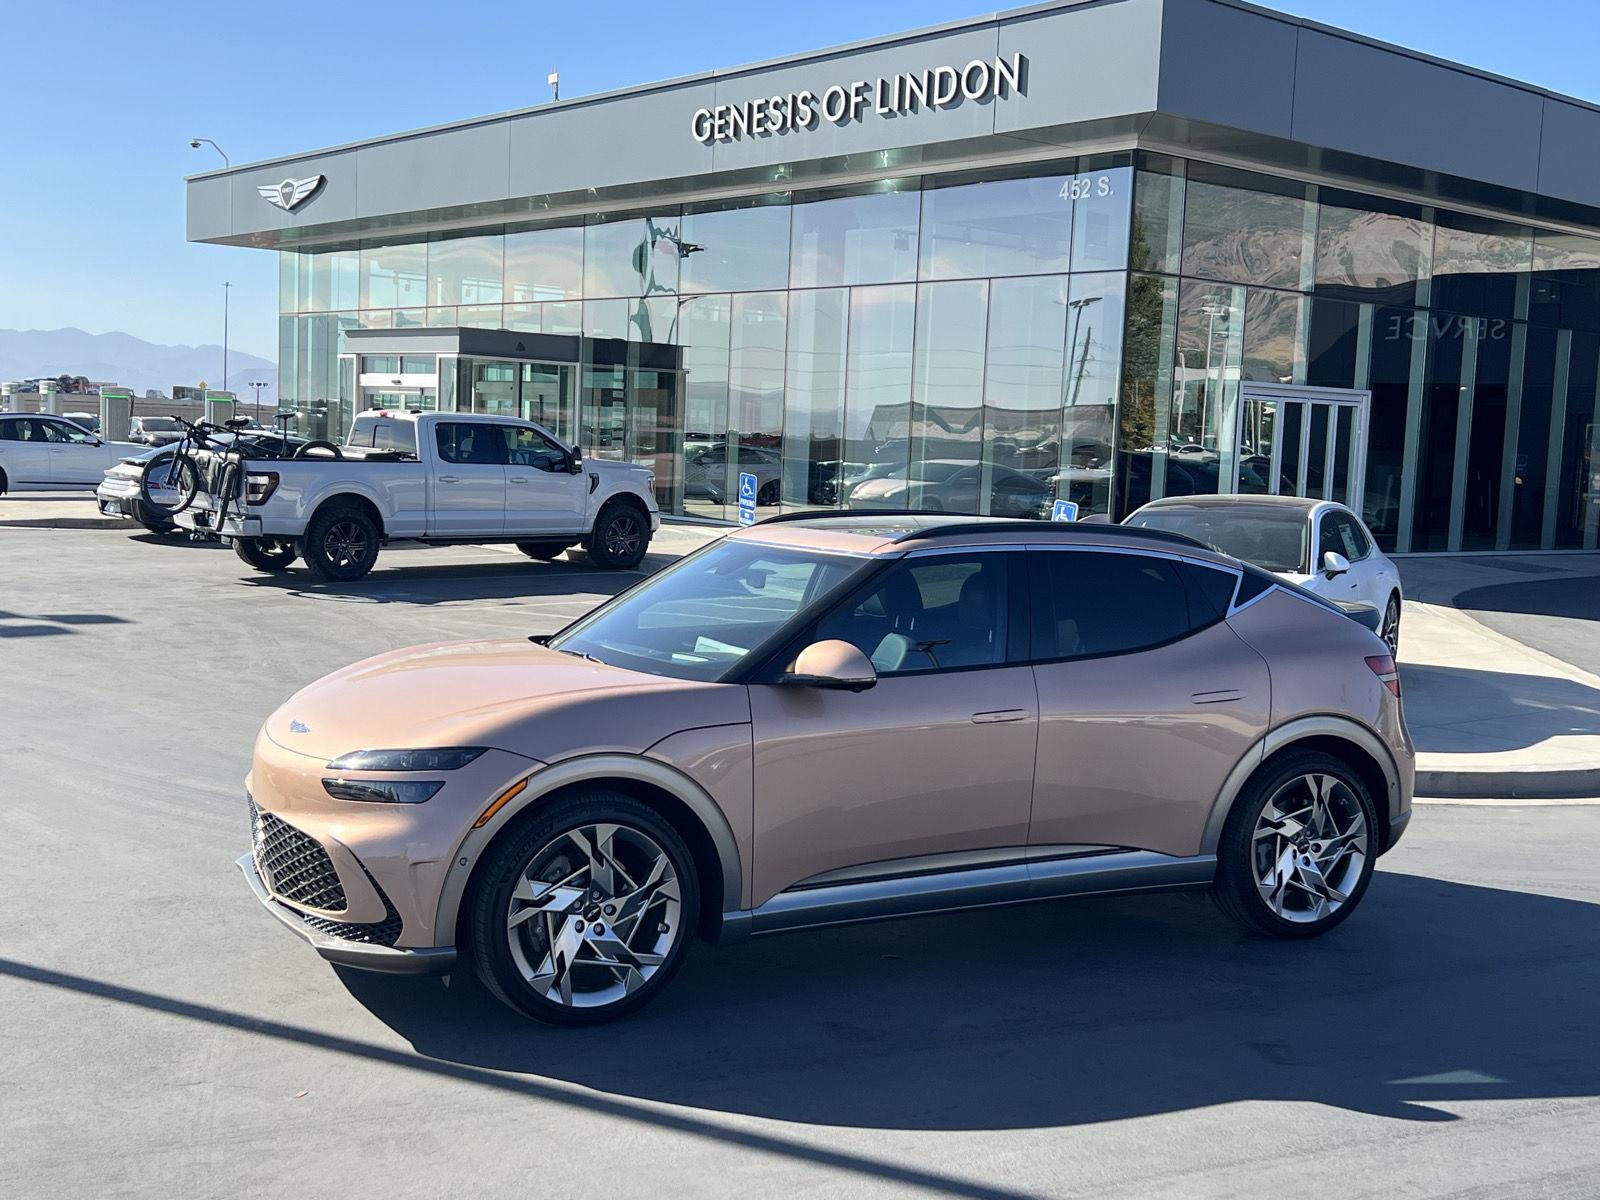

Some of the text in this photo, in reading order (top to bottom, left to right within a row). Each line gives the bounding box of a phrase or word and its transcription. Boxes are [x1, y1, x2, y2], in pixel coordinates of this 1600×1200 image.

[691, 52, 1022, 143] GENESIS OF LINDON
[1059, 175, 1114, 201] 452 S.
